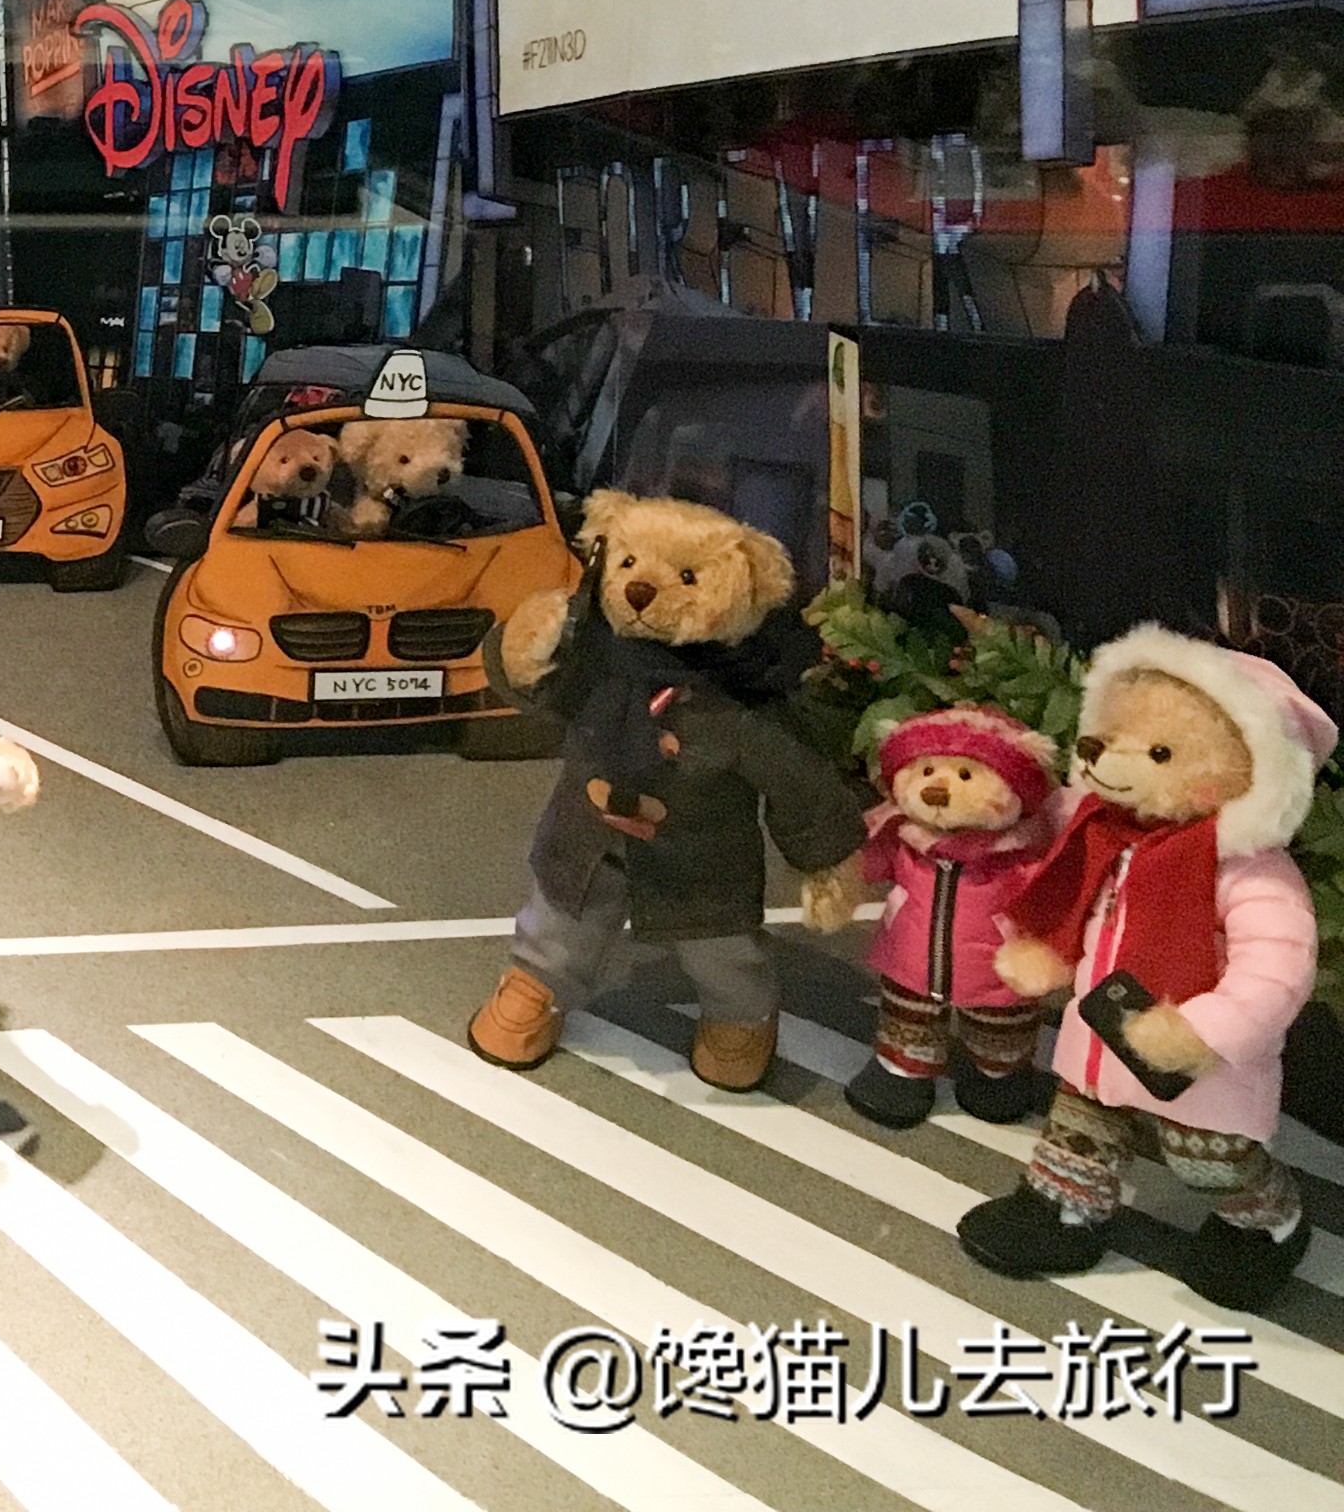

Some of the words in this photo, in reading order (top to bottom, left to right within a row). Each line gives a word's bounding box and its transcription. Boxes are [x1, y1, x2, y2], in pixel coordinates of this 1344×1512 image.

[380, 373, 423, 392] NYC
[333, 676, 376, 694] NYC
[386, 674, 431, 691] 5074
